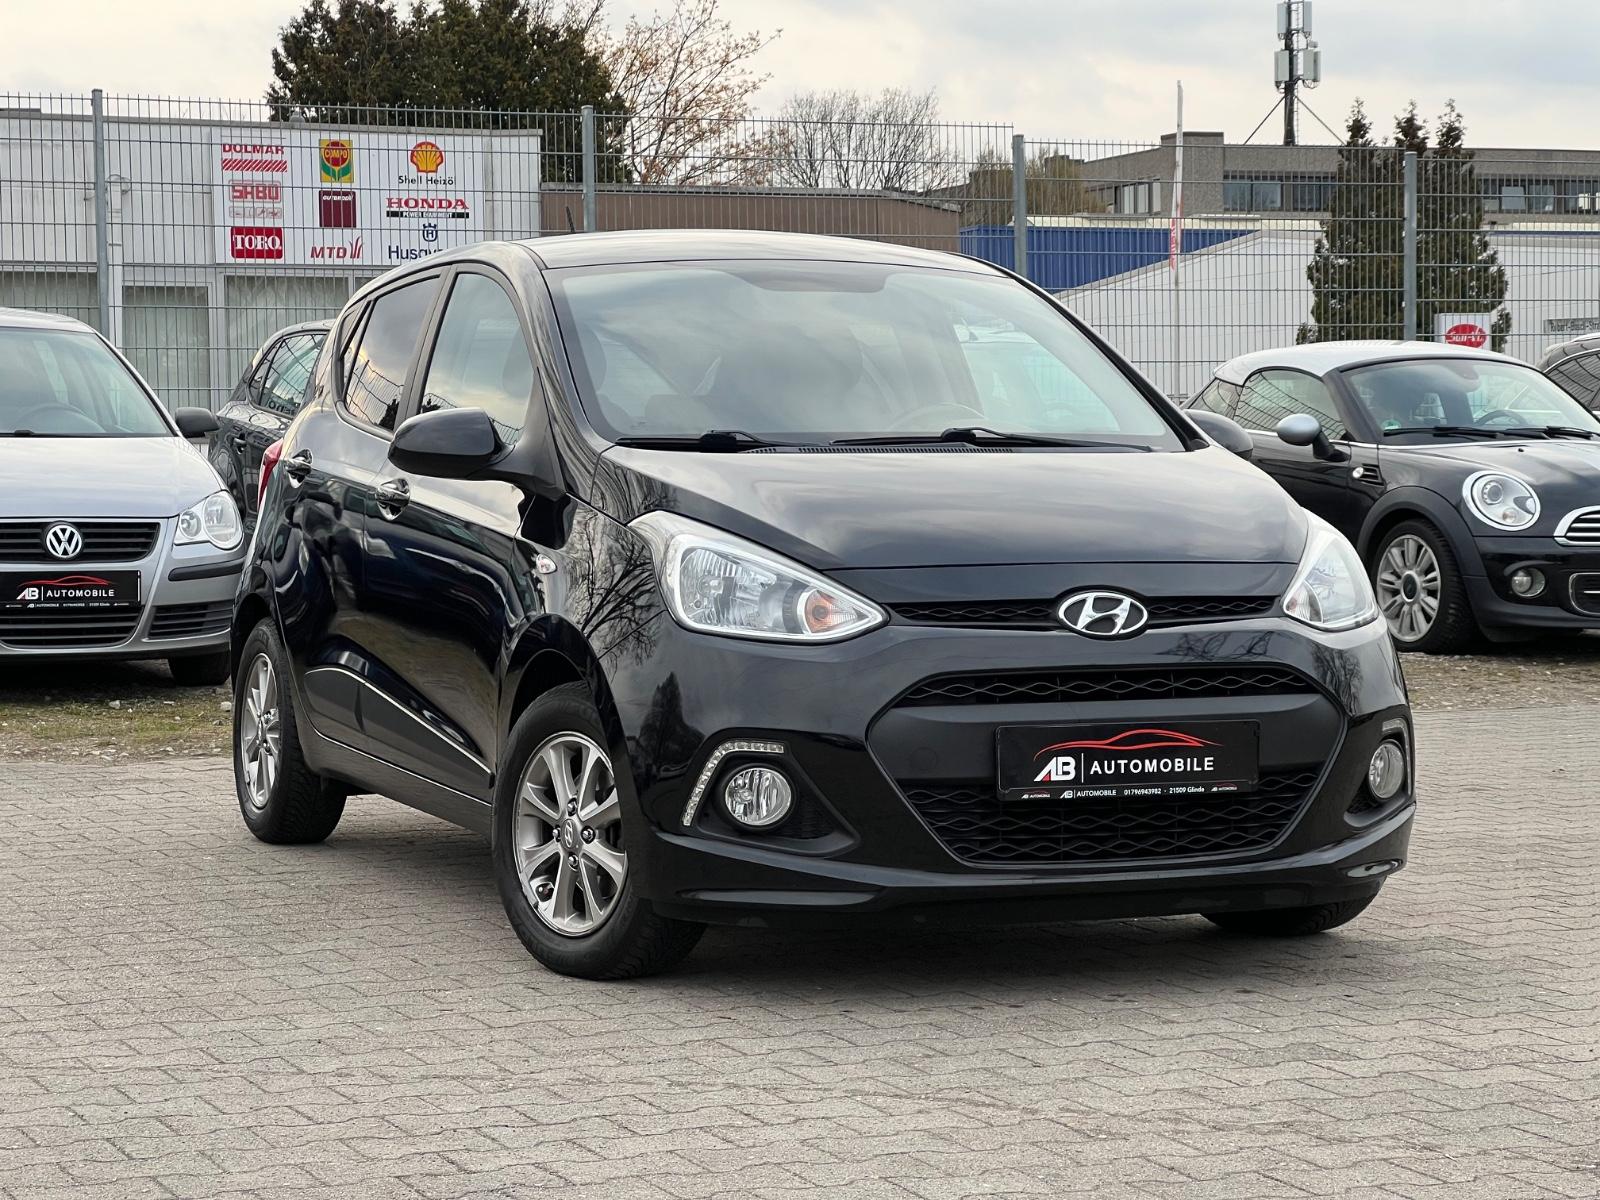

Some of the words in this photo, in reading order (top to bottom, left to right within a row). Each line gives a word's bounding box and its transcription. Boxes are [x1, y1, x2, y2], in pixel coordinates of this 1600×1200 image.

[222, 144, 285, 154] DOLMAR
[398, 175, 422, 184] Shell
[386, 197, 469, 209] HONDA
[233, 235, 282, 250] TORO
[310, 246, 347, 259] MTD
[46, 589, 115, 598] AUTOMOBILE
[1090, 757, 1214, 775] AUTOMOBILE
[1077, 789, 1117, 797] AUTOMOBILE
